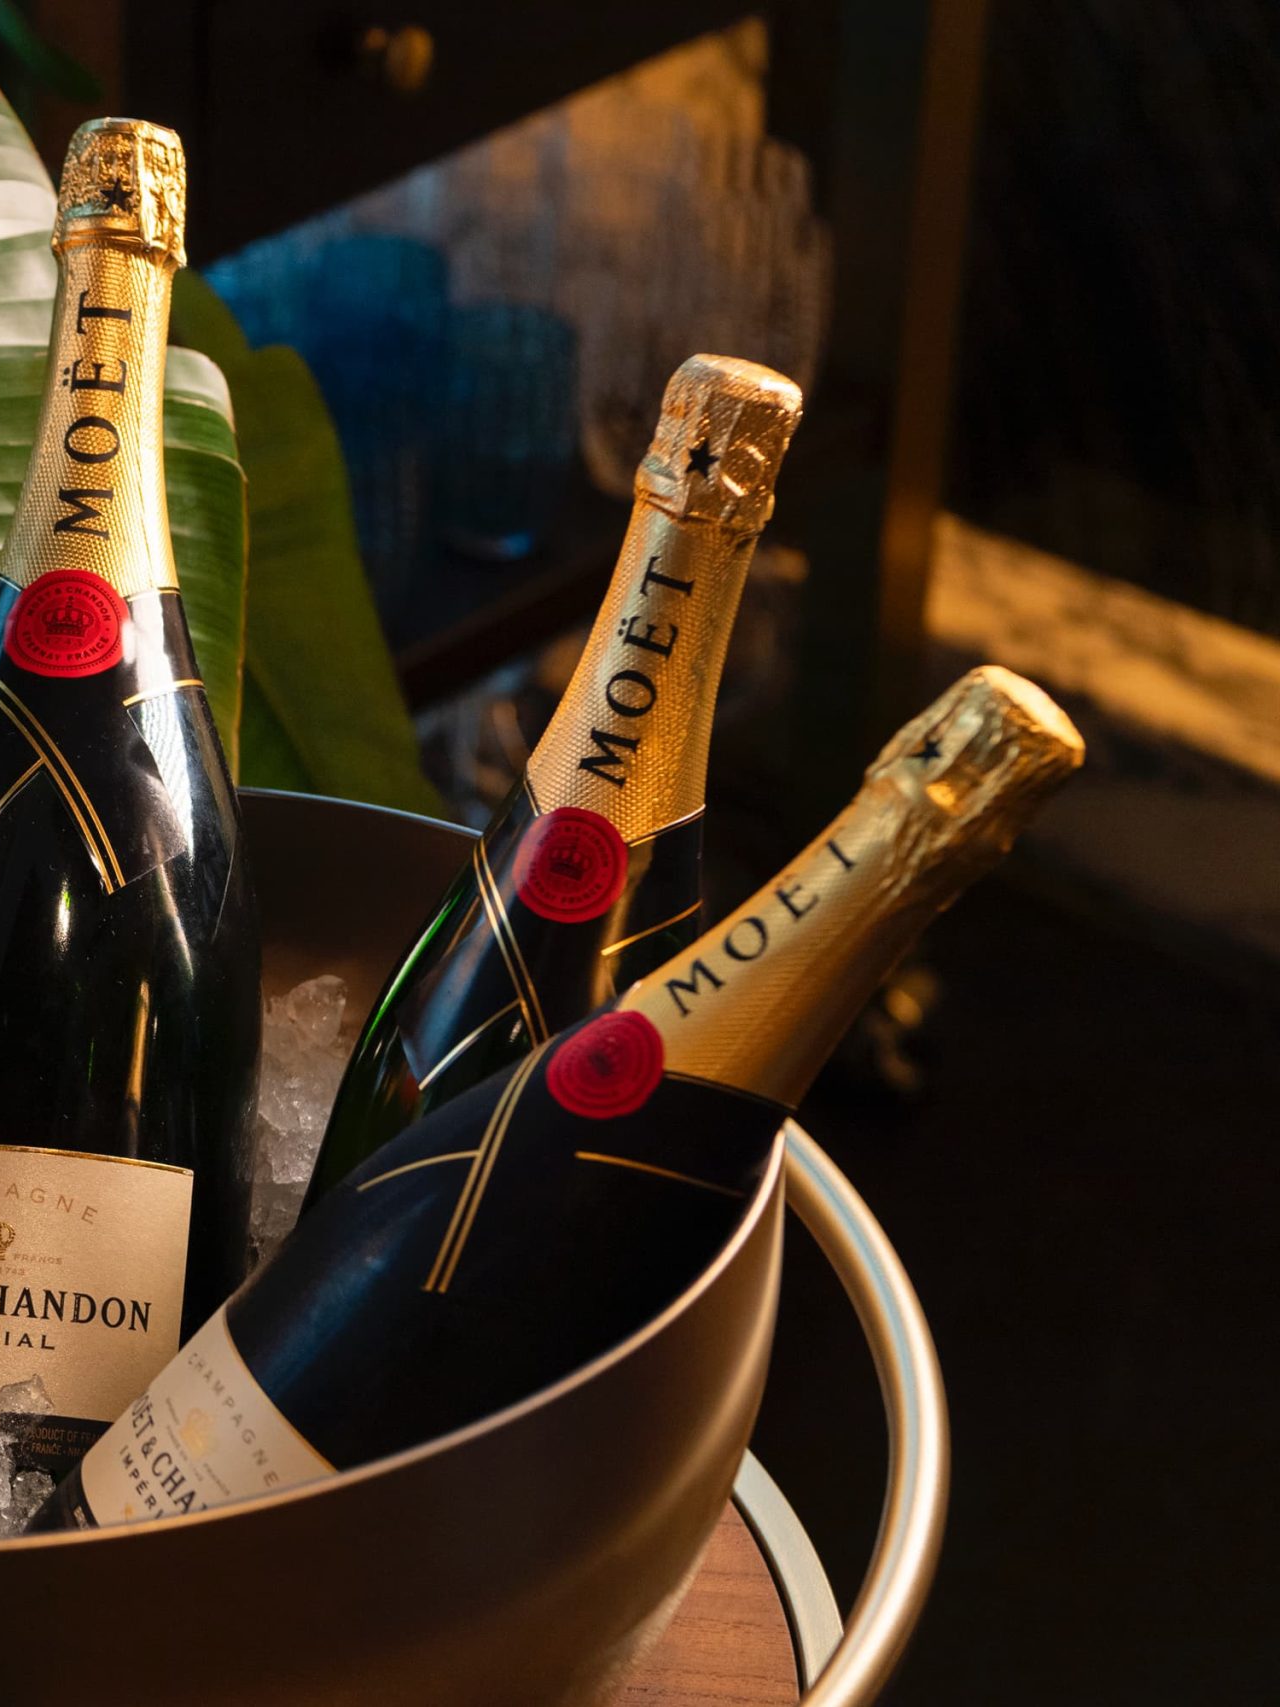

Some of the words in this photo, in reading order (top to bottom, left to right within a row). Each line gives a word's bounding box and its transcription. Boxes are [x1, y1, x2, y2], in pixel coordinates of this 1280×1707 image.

[53, 290, 133, 541] MOËT
[577, 555, 696, 790] MOËT
[119, 1444, 165, 1520] IMPÉRI
[140, 1435, 158, 1460] &
[150, 1451, 208, 1515] CHA
[186, 1352, 280, 1489] CHAMPAGNE
